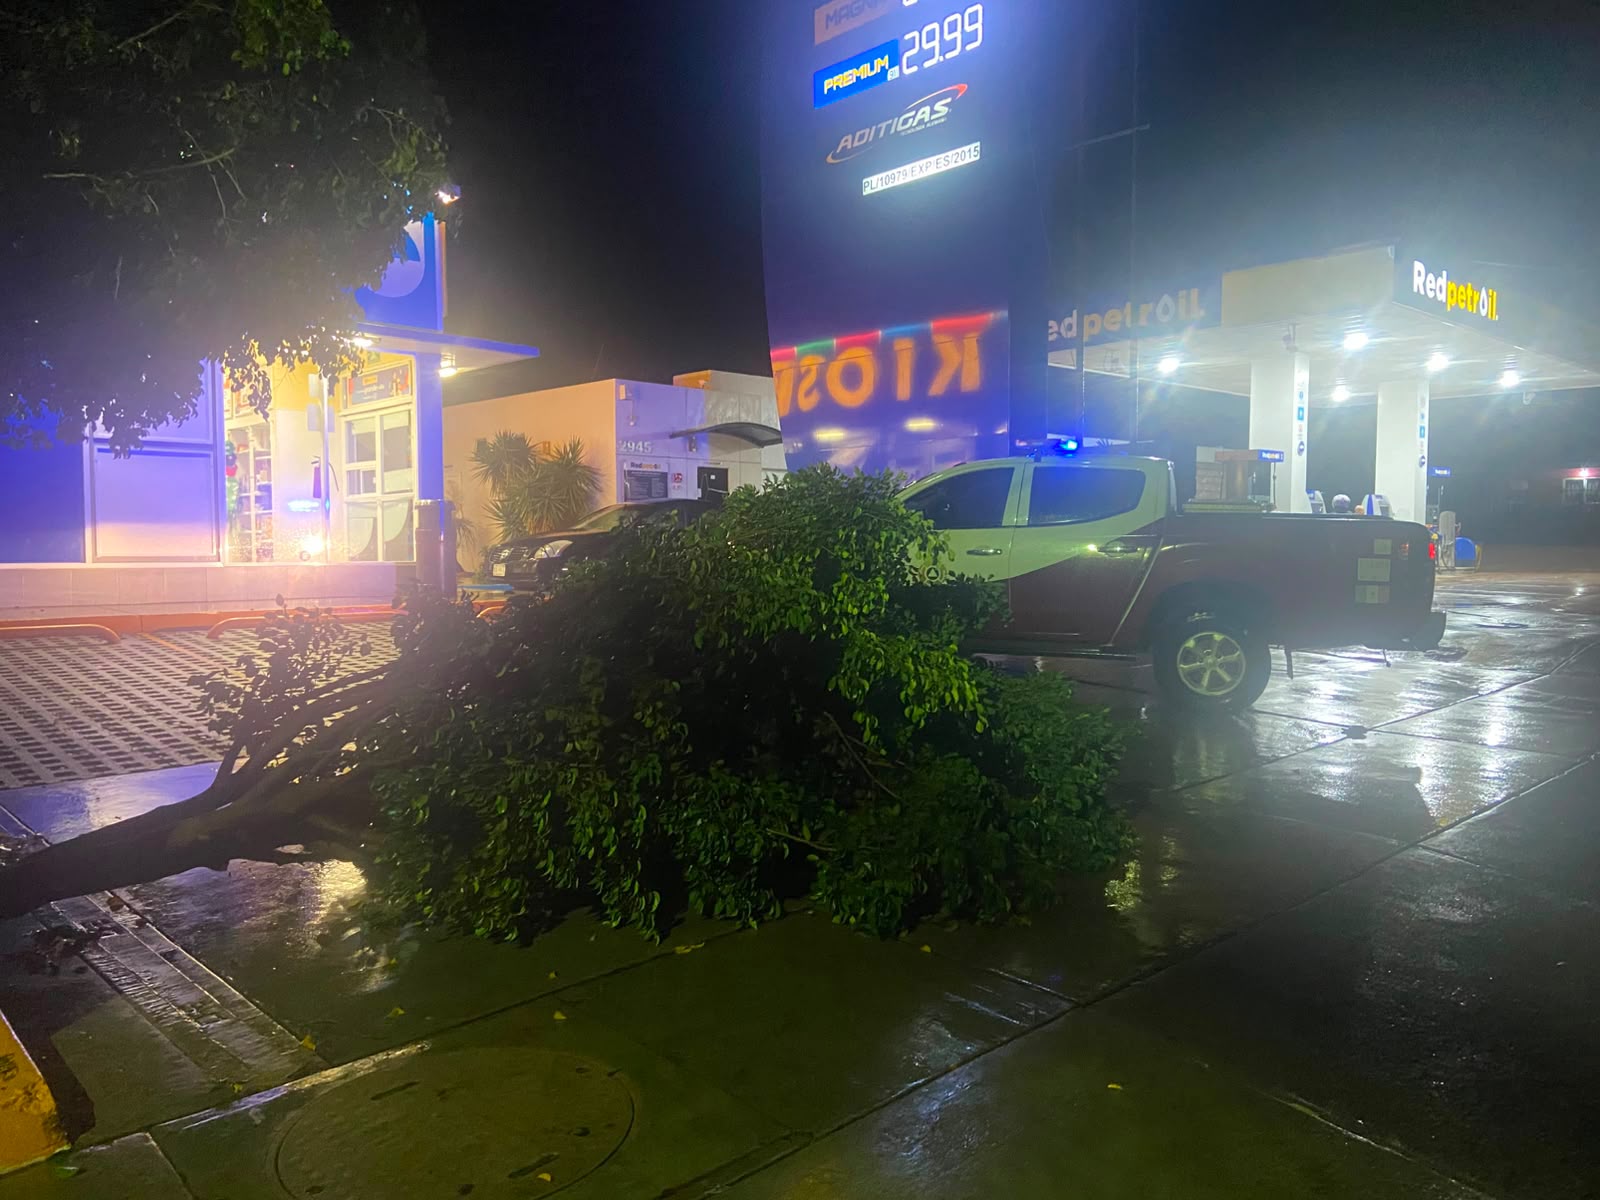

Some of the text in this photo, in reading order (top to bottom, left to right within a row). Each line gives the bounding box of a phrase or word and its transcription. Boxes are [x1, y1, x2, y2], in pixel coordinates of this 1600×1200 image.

[825, 0, 881, 30] MAGN
[902, 3, 983, 75] 29.99
[824, 54, 889, 95] PREMIUM
[836, 97, 952, 153] ADITIGAS
